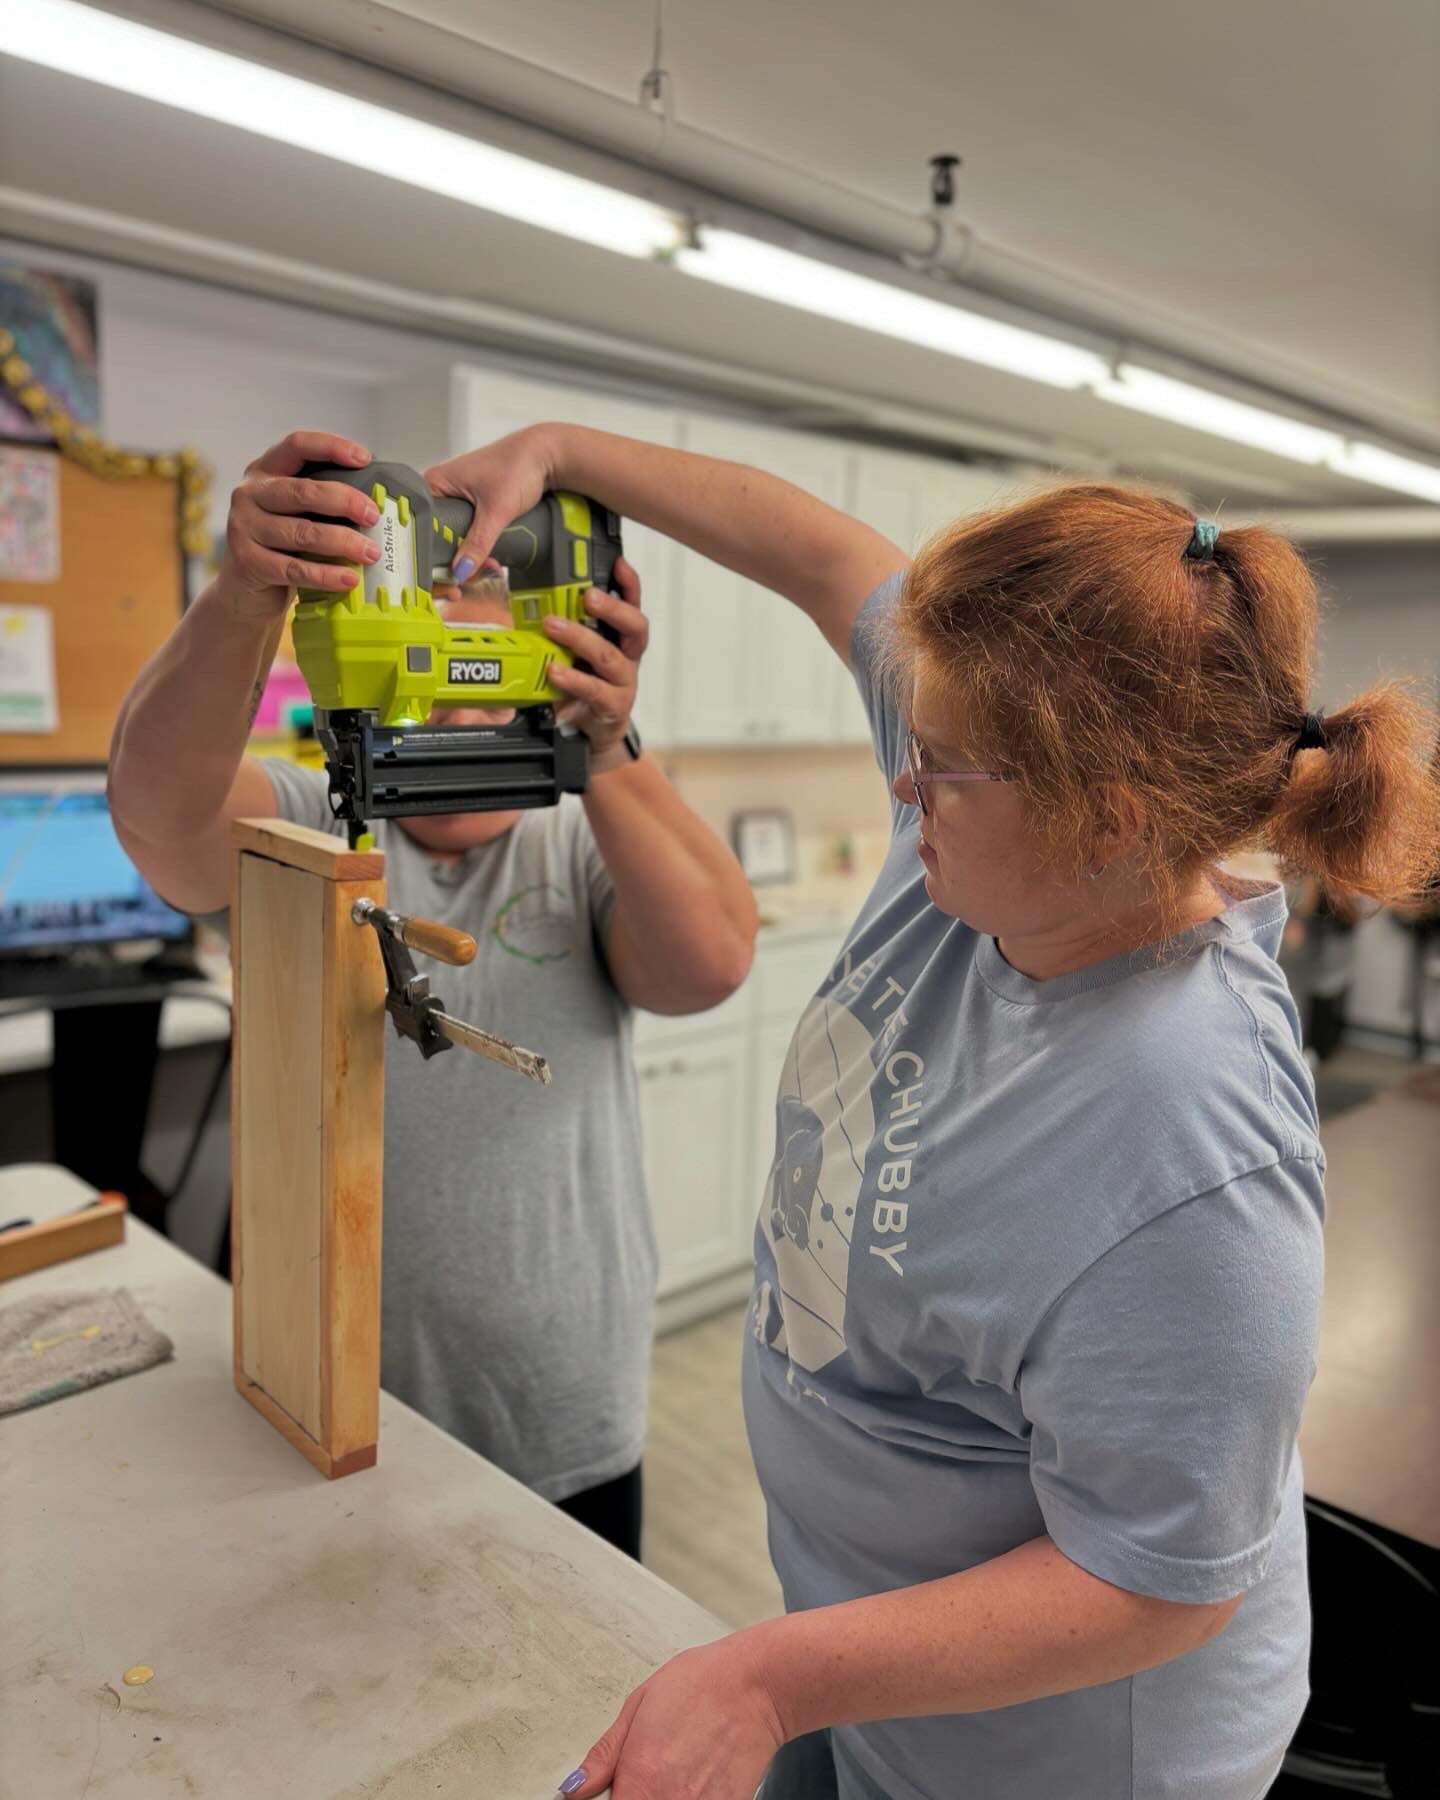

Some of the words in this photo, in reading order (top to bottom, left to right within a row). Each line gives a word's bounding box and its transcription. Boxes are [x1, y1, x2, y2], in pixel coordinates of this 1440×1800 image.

[384, 516, 394, 573] AirStrike
[450, 662, 500, 681] RYOBI
[869, 1050, 925, 1277] CHUBBY
